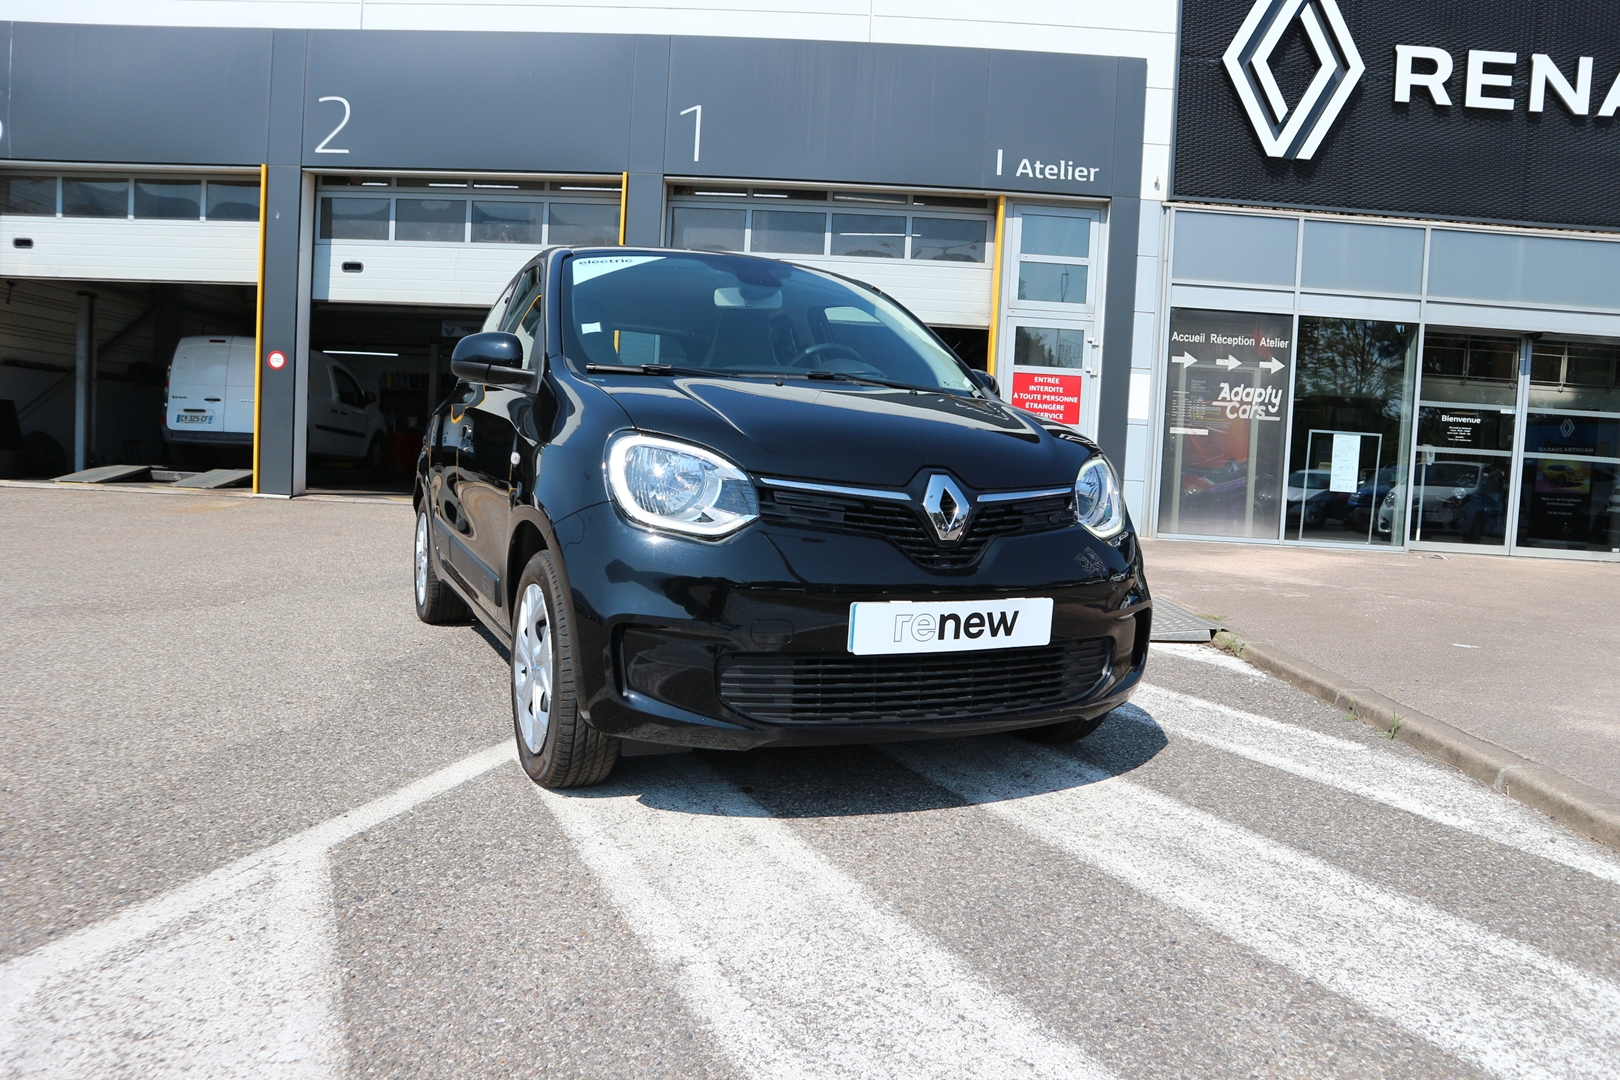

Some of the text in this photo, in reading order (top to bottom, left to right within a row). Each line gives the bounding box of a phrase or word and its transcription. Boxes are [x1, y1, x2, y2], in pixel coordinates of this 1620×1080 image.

[315, 96, 350, 153] 2
[680, 105, 701, 161] 1
[1016, 159, 1099, 181] Atelier
[1171, 331, 1290, 348] Accueil Réception Atelier
[1034, 376, 1060, 384] ENTRÉE
[1029, 385, 1064, 393] INTERDITE
[1218, 382, 1283, 413] Adapty
[1025, 402, 1064, 411] ÉTRANGÈRE
[1042, 395, 1078, 403] PERSONNE
[1442, 415, 1481, 424] Bienvenue
[893, 610, 1020, 642] renew
